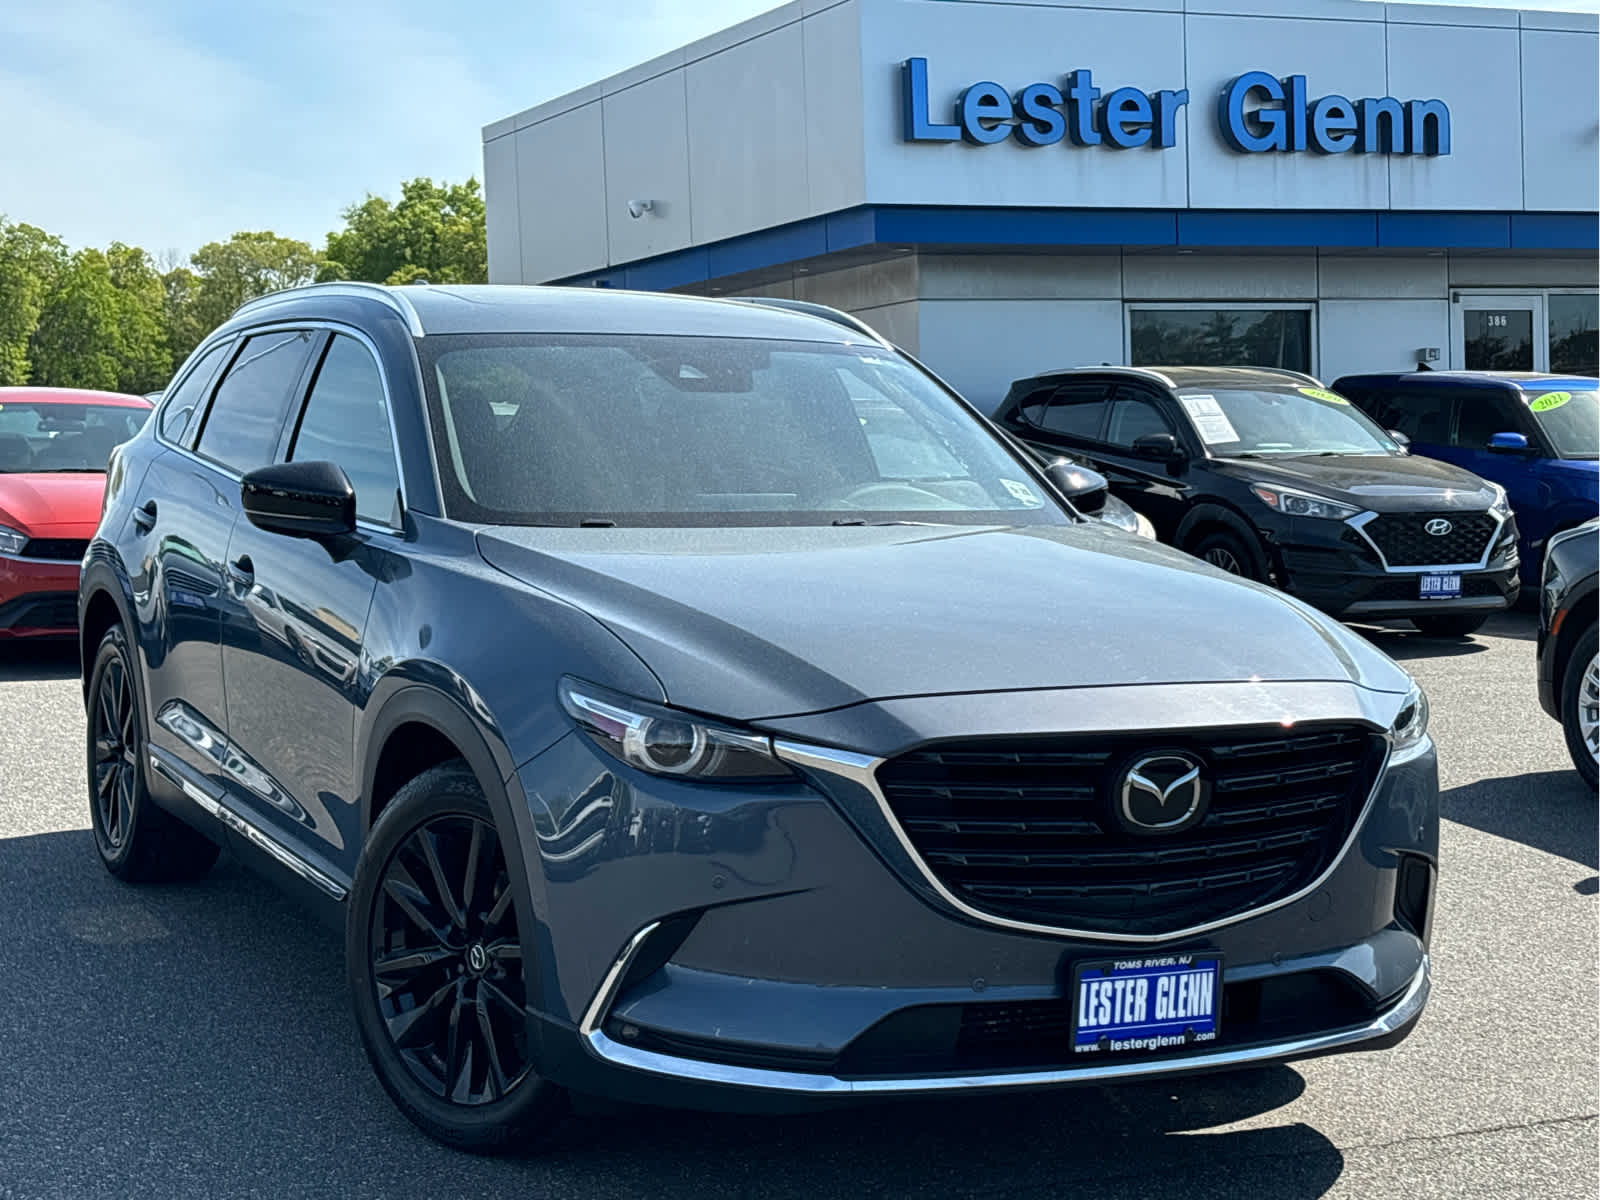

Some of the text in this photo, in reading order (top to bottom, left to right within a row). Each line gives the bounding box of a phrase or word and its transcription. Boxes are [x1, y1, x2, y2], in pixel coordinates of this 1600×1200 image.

[902, 57, 1451, 155] Lester Glenn
[1488, 315, 1507, 327] 386
[1539, 393, 1562, 410] 2021
[1114, 960, 1143, 970] TOMS
[1179, 955, 1193, 965] NJ
[1078, 972, 1214, 1028] LESTER GLENN
